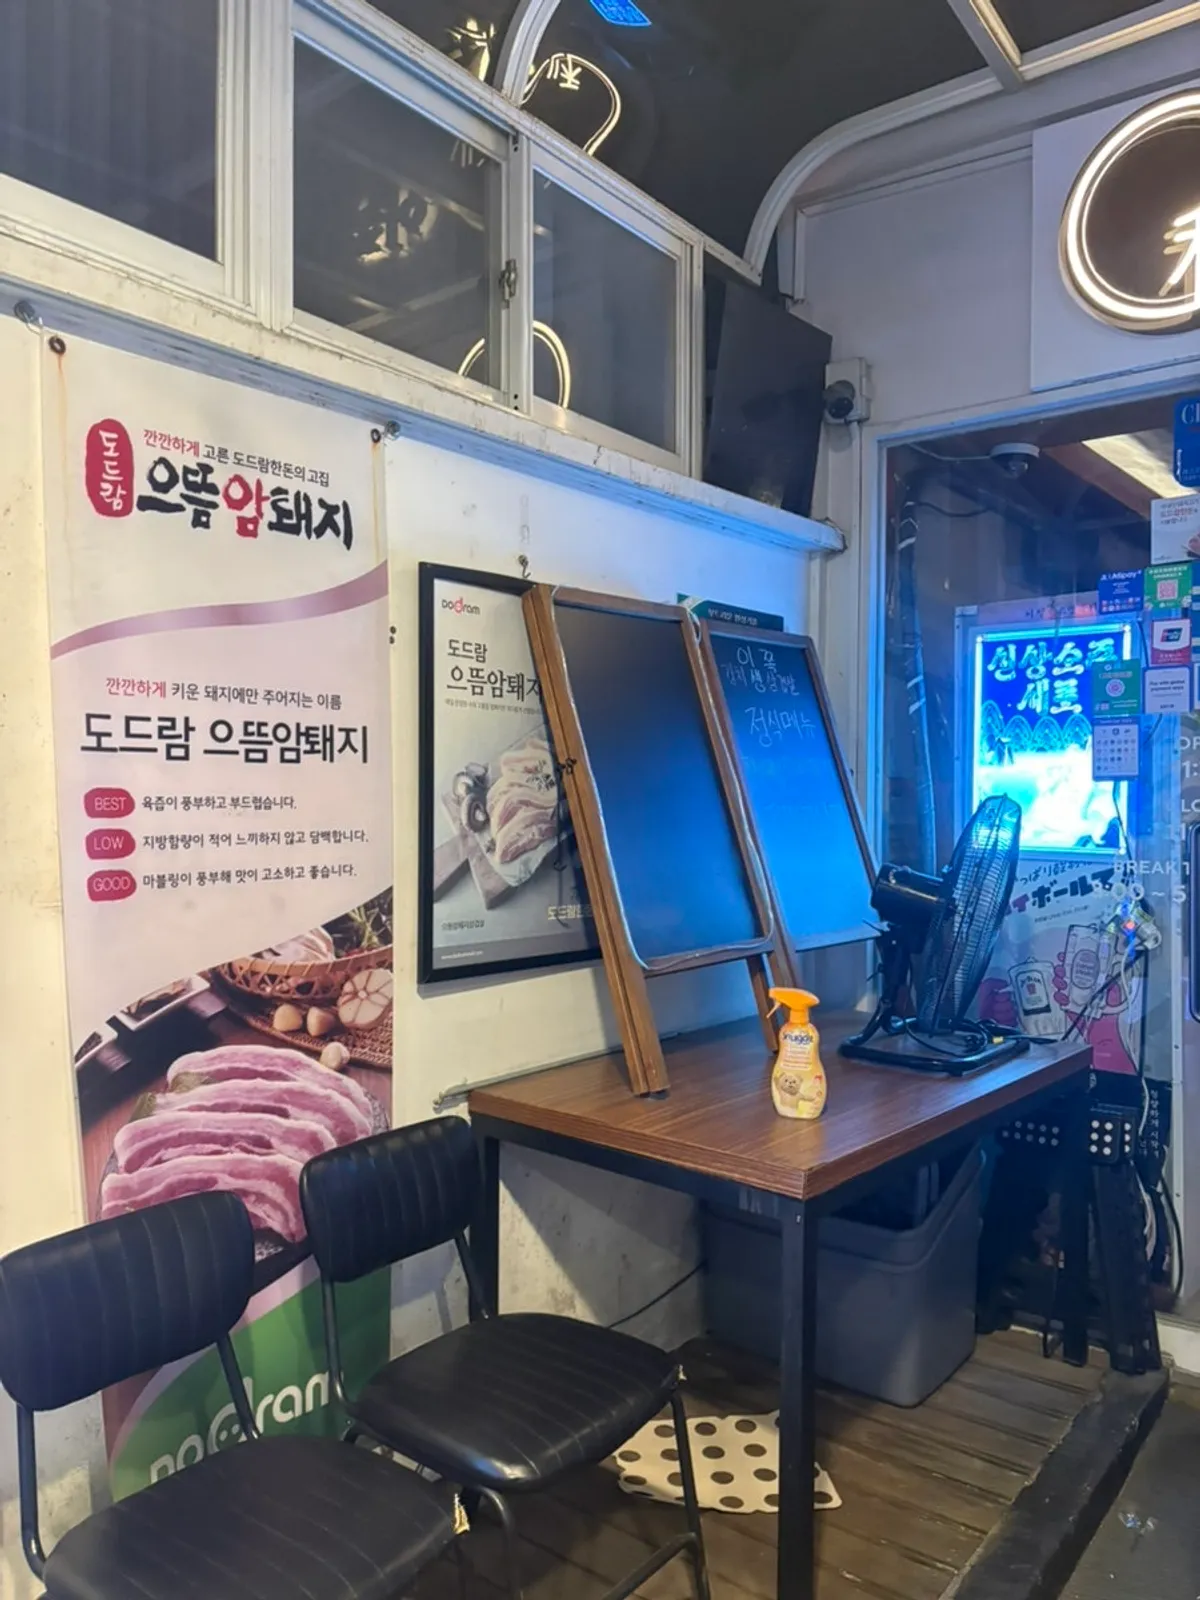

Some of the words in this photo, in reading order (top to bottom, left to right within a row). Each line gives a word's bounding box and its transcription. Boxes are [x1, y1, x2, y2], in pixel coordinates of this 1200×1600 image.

[98, 429, 127, 511] 도드람
[144, 429, 200, 457] 깐깐하게
[202, 445, 229, 464] 고른
[232, 451, 306, 482] 도드람한돈의
[307, 469, 330, 487] 고집
[136, 456, 353, 551] 으뜸암퇘지
[447, 638, 488, 663] 도드람
[106, 677, 167, 698] 깐깐하게
[171, 682, 200, 701] 키운
[204, 685, 259, 705] 돼지에만
[262, 689, 314, 709] 주어지는
[317, 693, 342, 710] 이름
[1016, 677, 1083, 716] 새로
[80, 712, 196, 761] 도드람
[203, 718, 368, 764] 으뜸암퇘지
[94, 796, 127, 810] BEST
[142, 795, 178, 811] 육즙이
[181, 795, 227, 812] 풍부하고
[229, 795, 297, 811] 부드럽습니다.
[93, 836, 124, 850] LOW
[143, 833, 204, 851] 지방함량이
[208, 833, 232, 848] 적어
[235, 832, 281, 846] 느끼하지
[283, 831, 306, 845] 않고
[309, 830, 369, 845] 담백합니다.
[93, 876, 130, 892] GOOD
[142, 872, 192, 889] 마블링이
[196, 870, 232, 887] 풍부해
[235, 868, 258, 884] 맛이
[262, 866, 306, 881] 고소하고
[309, 864, 357, 880] 좋습니다.
